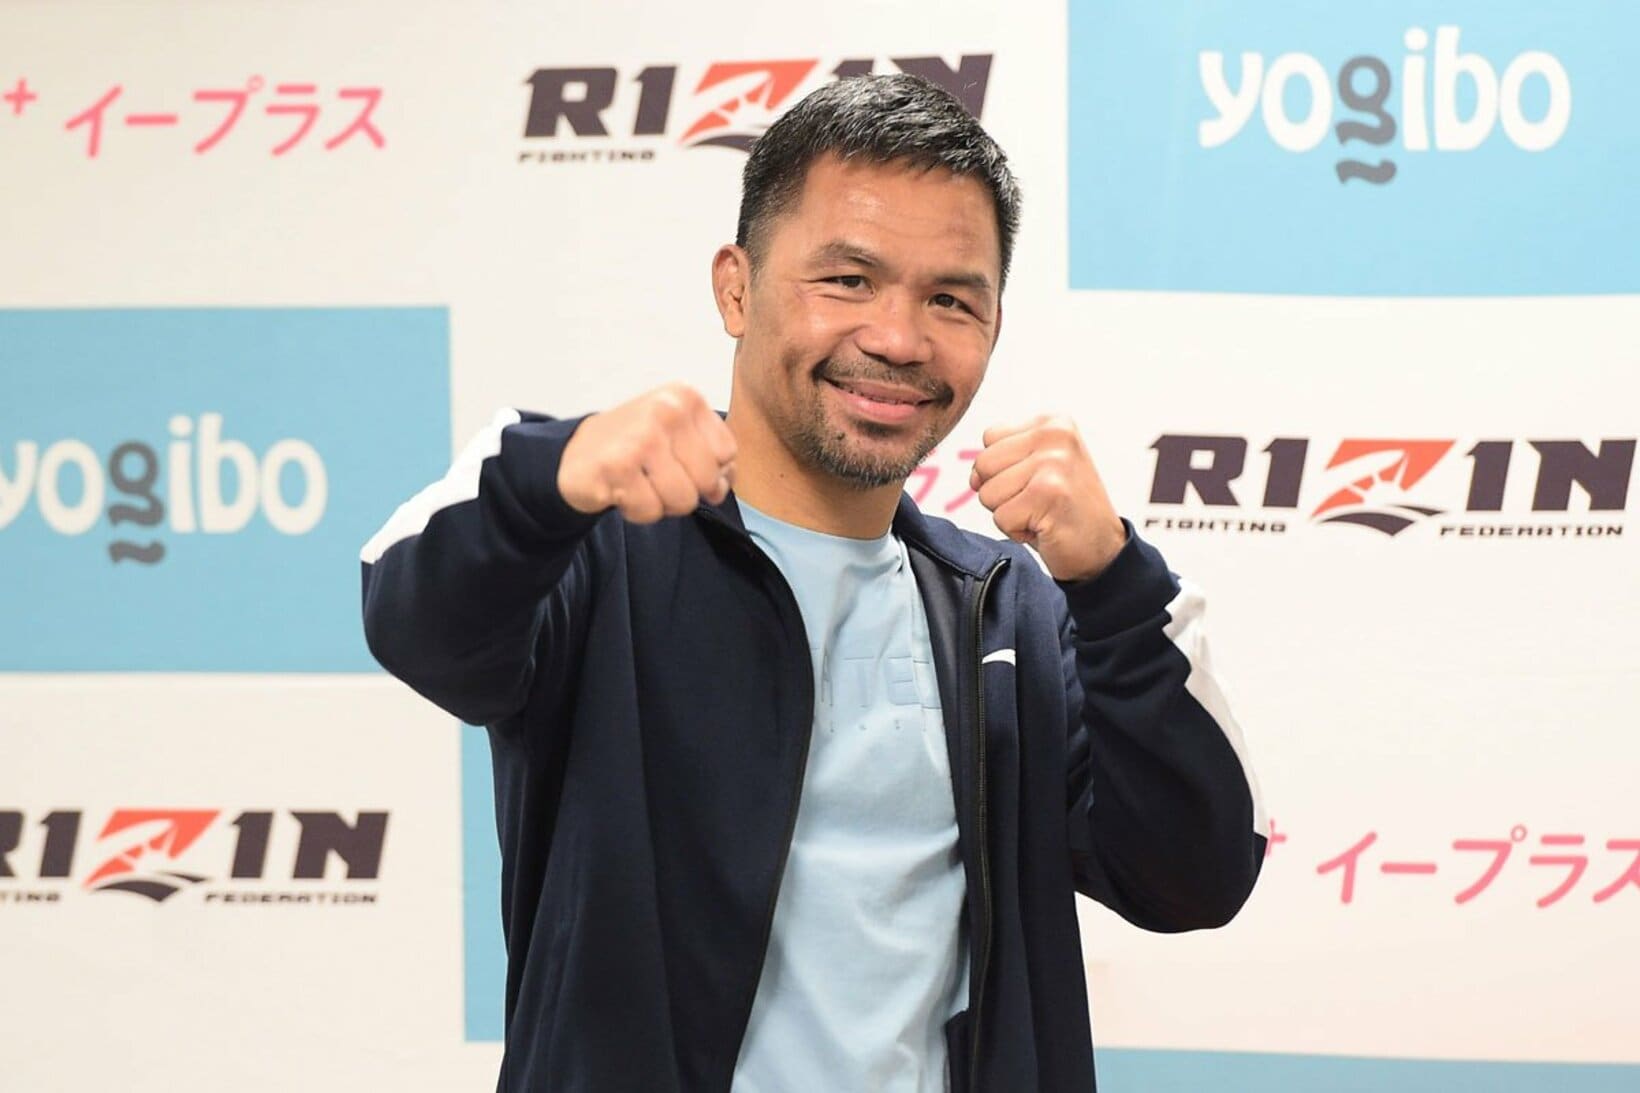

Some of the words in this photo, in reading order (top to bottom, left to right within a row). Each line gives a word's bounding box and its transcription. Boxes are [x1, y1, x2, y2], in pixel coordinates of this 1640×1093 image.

[64, 76, 386, 158] イープラス
[1199, 26, 1571, 185] yogibo
[518, 149, 656, 164] FIGHTING
[1144, 517, 1287, 534] FIGHTING
[1440, 523, 1625, 538] FEDERATION
[1316, 824, 1640, 908] イープラス
[205, 891, 378, 905] FEDERATION
